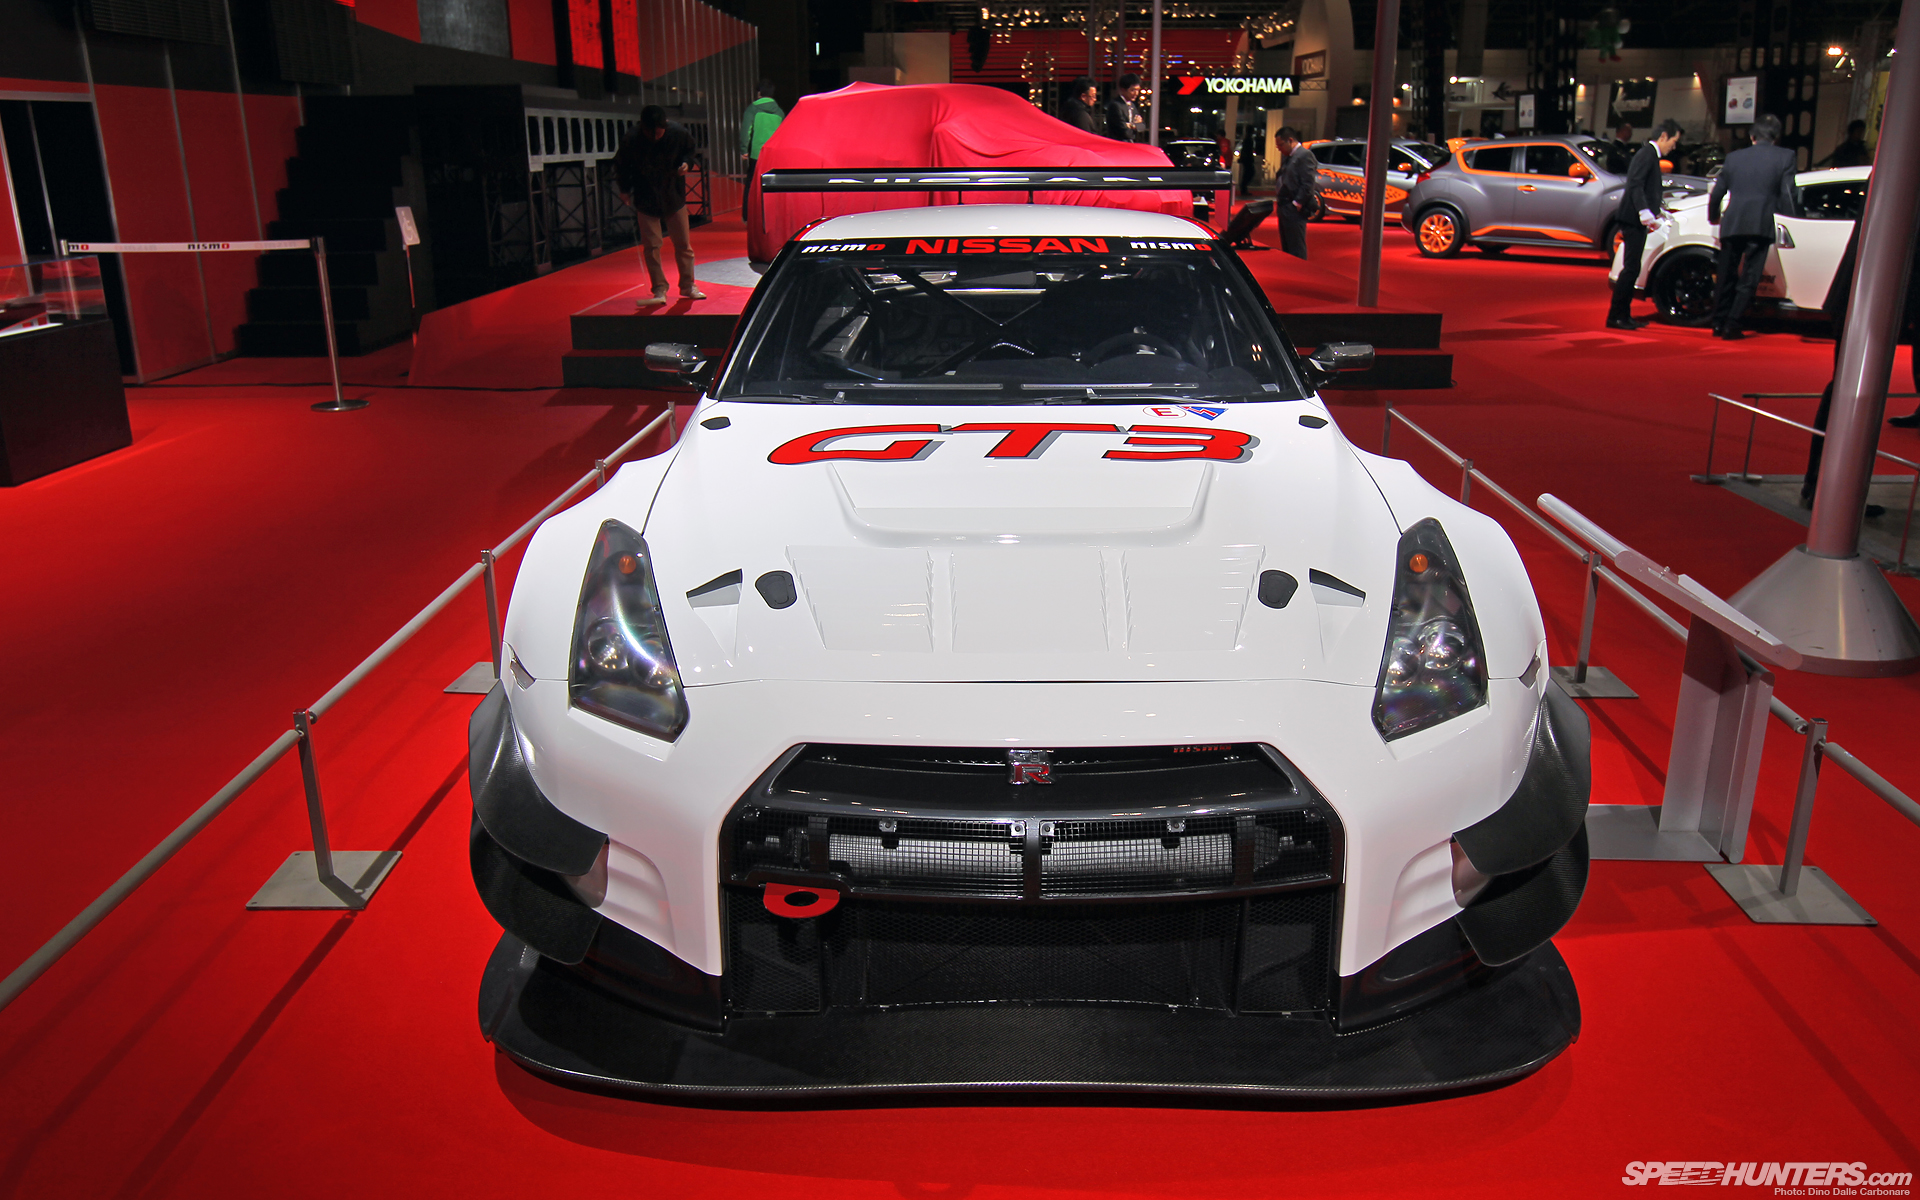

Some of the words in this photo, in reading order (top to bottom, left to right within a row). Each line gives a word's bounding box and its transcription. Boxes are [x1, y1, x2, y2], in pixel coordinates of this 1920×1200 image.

[1204, 77, 1294, 93] YOKOHAMA
[187, 242, 230, 250] nismo
[801, 243, 885, 255] nismo
[905, 238, 1110, 255] NISSAN
[1129, 241, 1212, 252] nismo
[766, 422, 1260, 464] GT3
